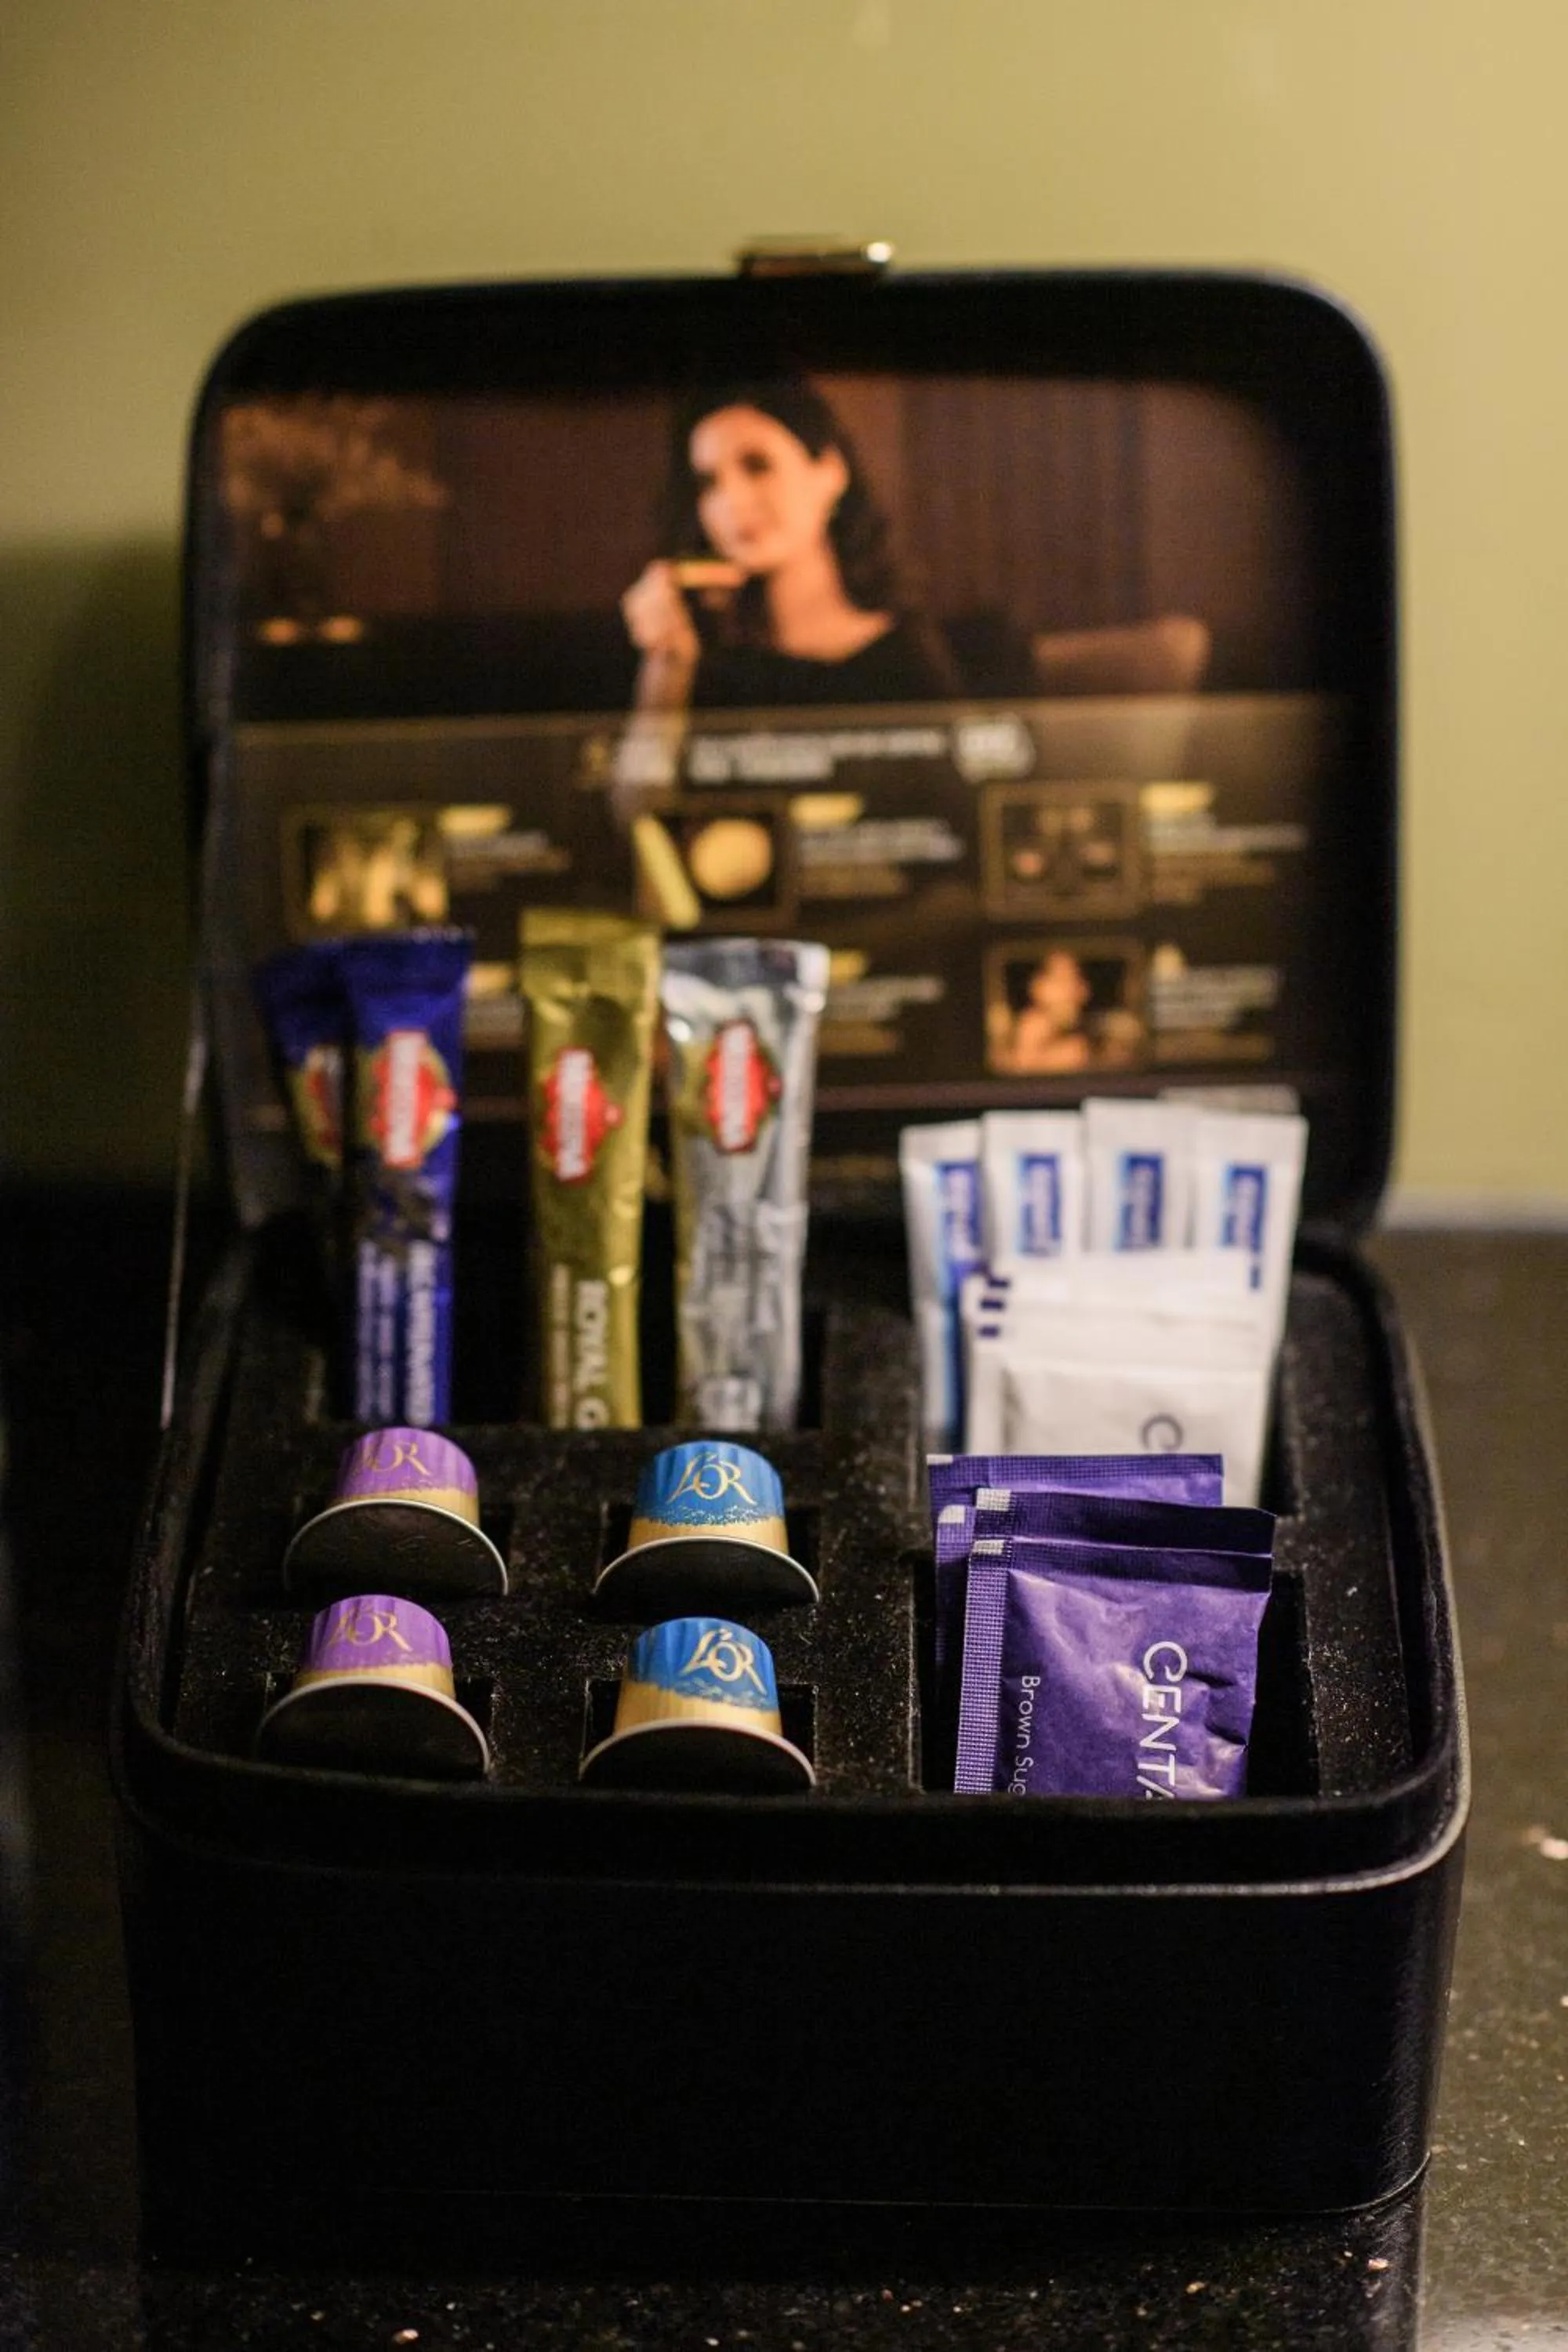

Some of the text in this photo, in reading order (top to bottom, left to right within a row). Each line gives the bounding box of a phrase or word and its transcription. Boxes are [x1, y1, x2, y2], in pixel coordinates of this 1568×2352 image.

[666, 1454, 757, 1506] L'OR
[680, 1627, 768, 1697] L'OR
[1015, 1675, 1041, 1749] Brown
